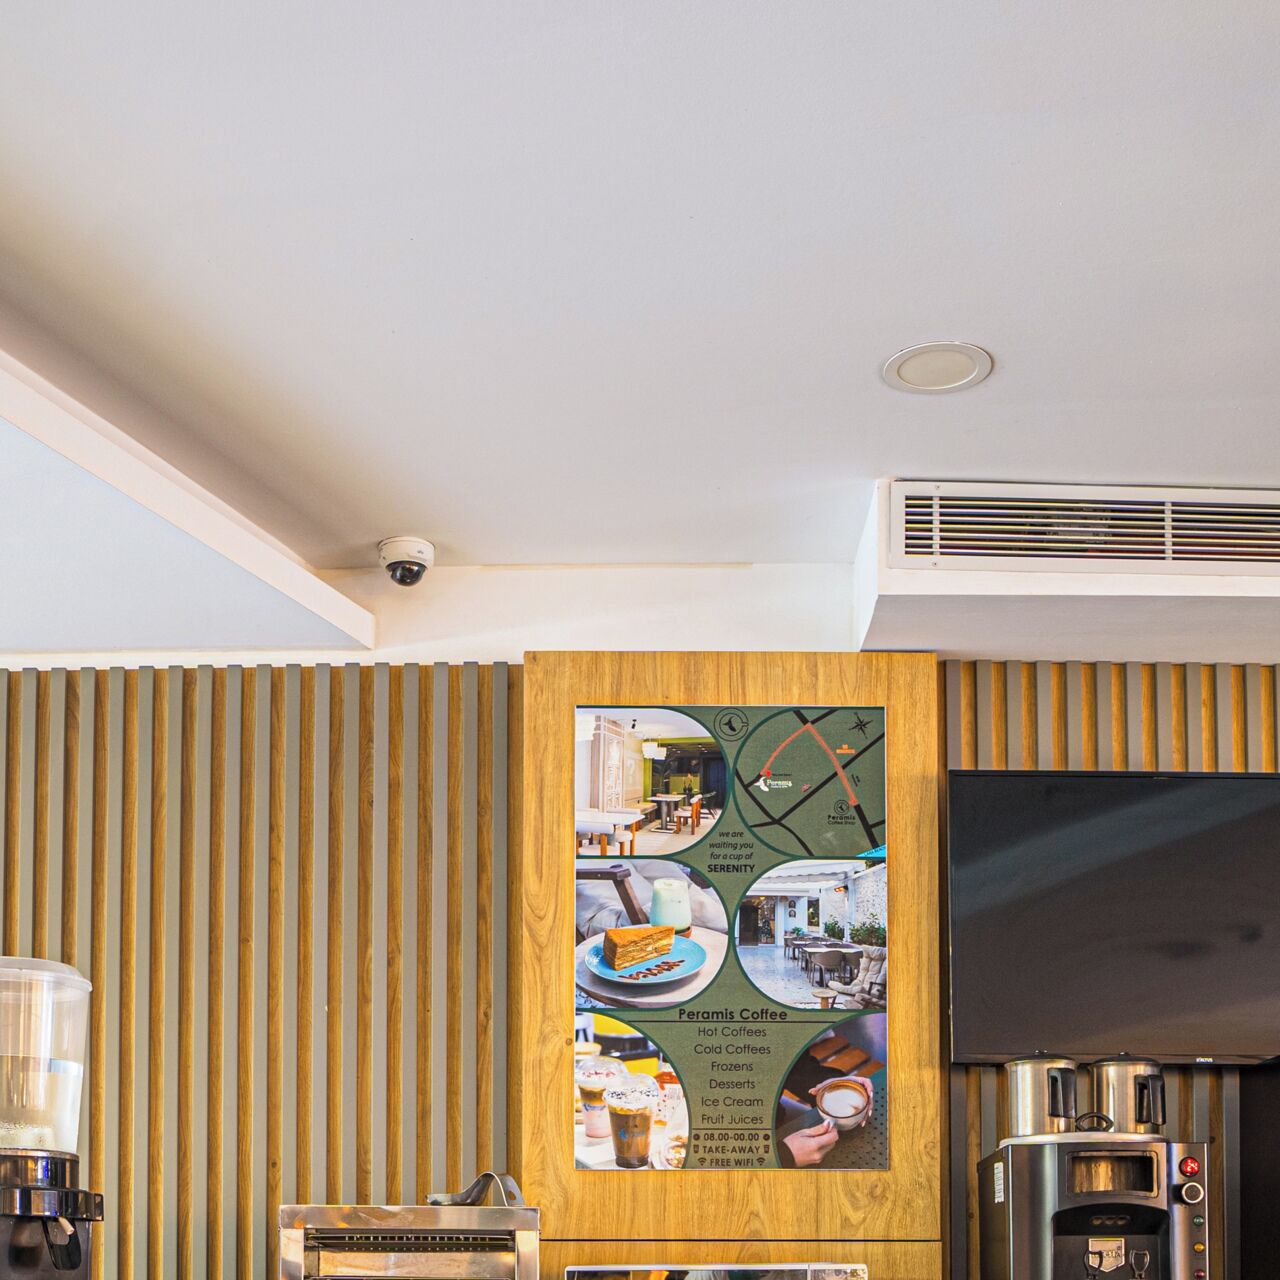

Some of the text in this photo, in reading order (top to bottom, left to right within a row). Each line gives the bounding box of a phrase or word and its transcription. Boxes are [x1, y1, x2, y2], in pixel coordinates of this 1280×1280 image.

[709, 841, 754, 850] waiting you
[707, 864, 756, 872] SERENITY
[678, 1008, 788, 1020] Peramis Coffee
[698, 1026, 767, 1037] Hot Coffees
[694, 1044, 771, 1054] Cold Coffees
[711, 1061, 754, 1072] Frozens
[709, 1078, 756, 1089] Desserts
[701, 1096, 764, 1107] Ice Cream
[701, 1114, 764, 1124] Fruit Juices
[703, 1132, 760, 1141] 08.00-00.00
[702, 1145, 760, 1154] TAKE-AWAY
[710, 1158, 754, 1166] FREE WIFI
